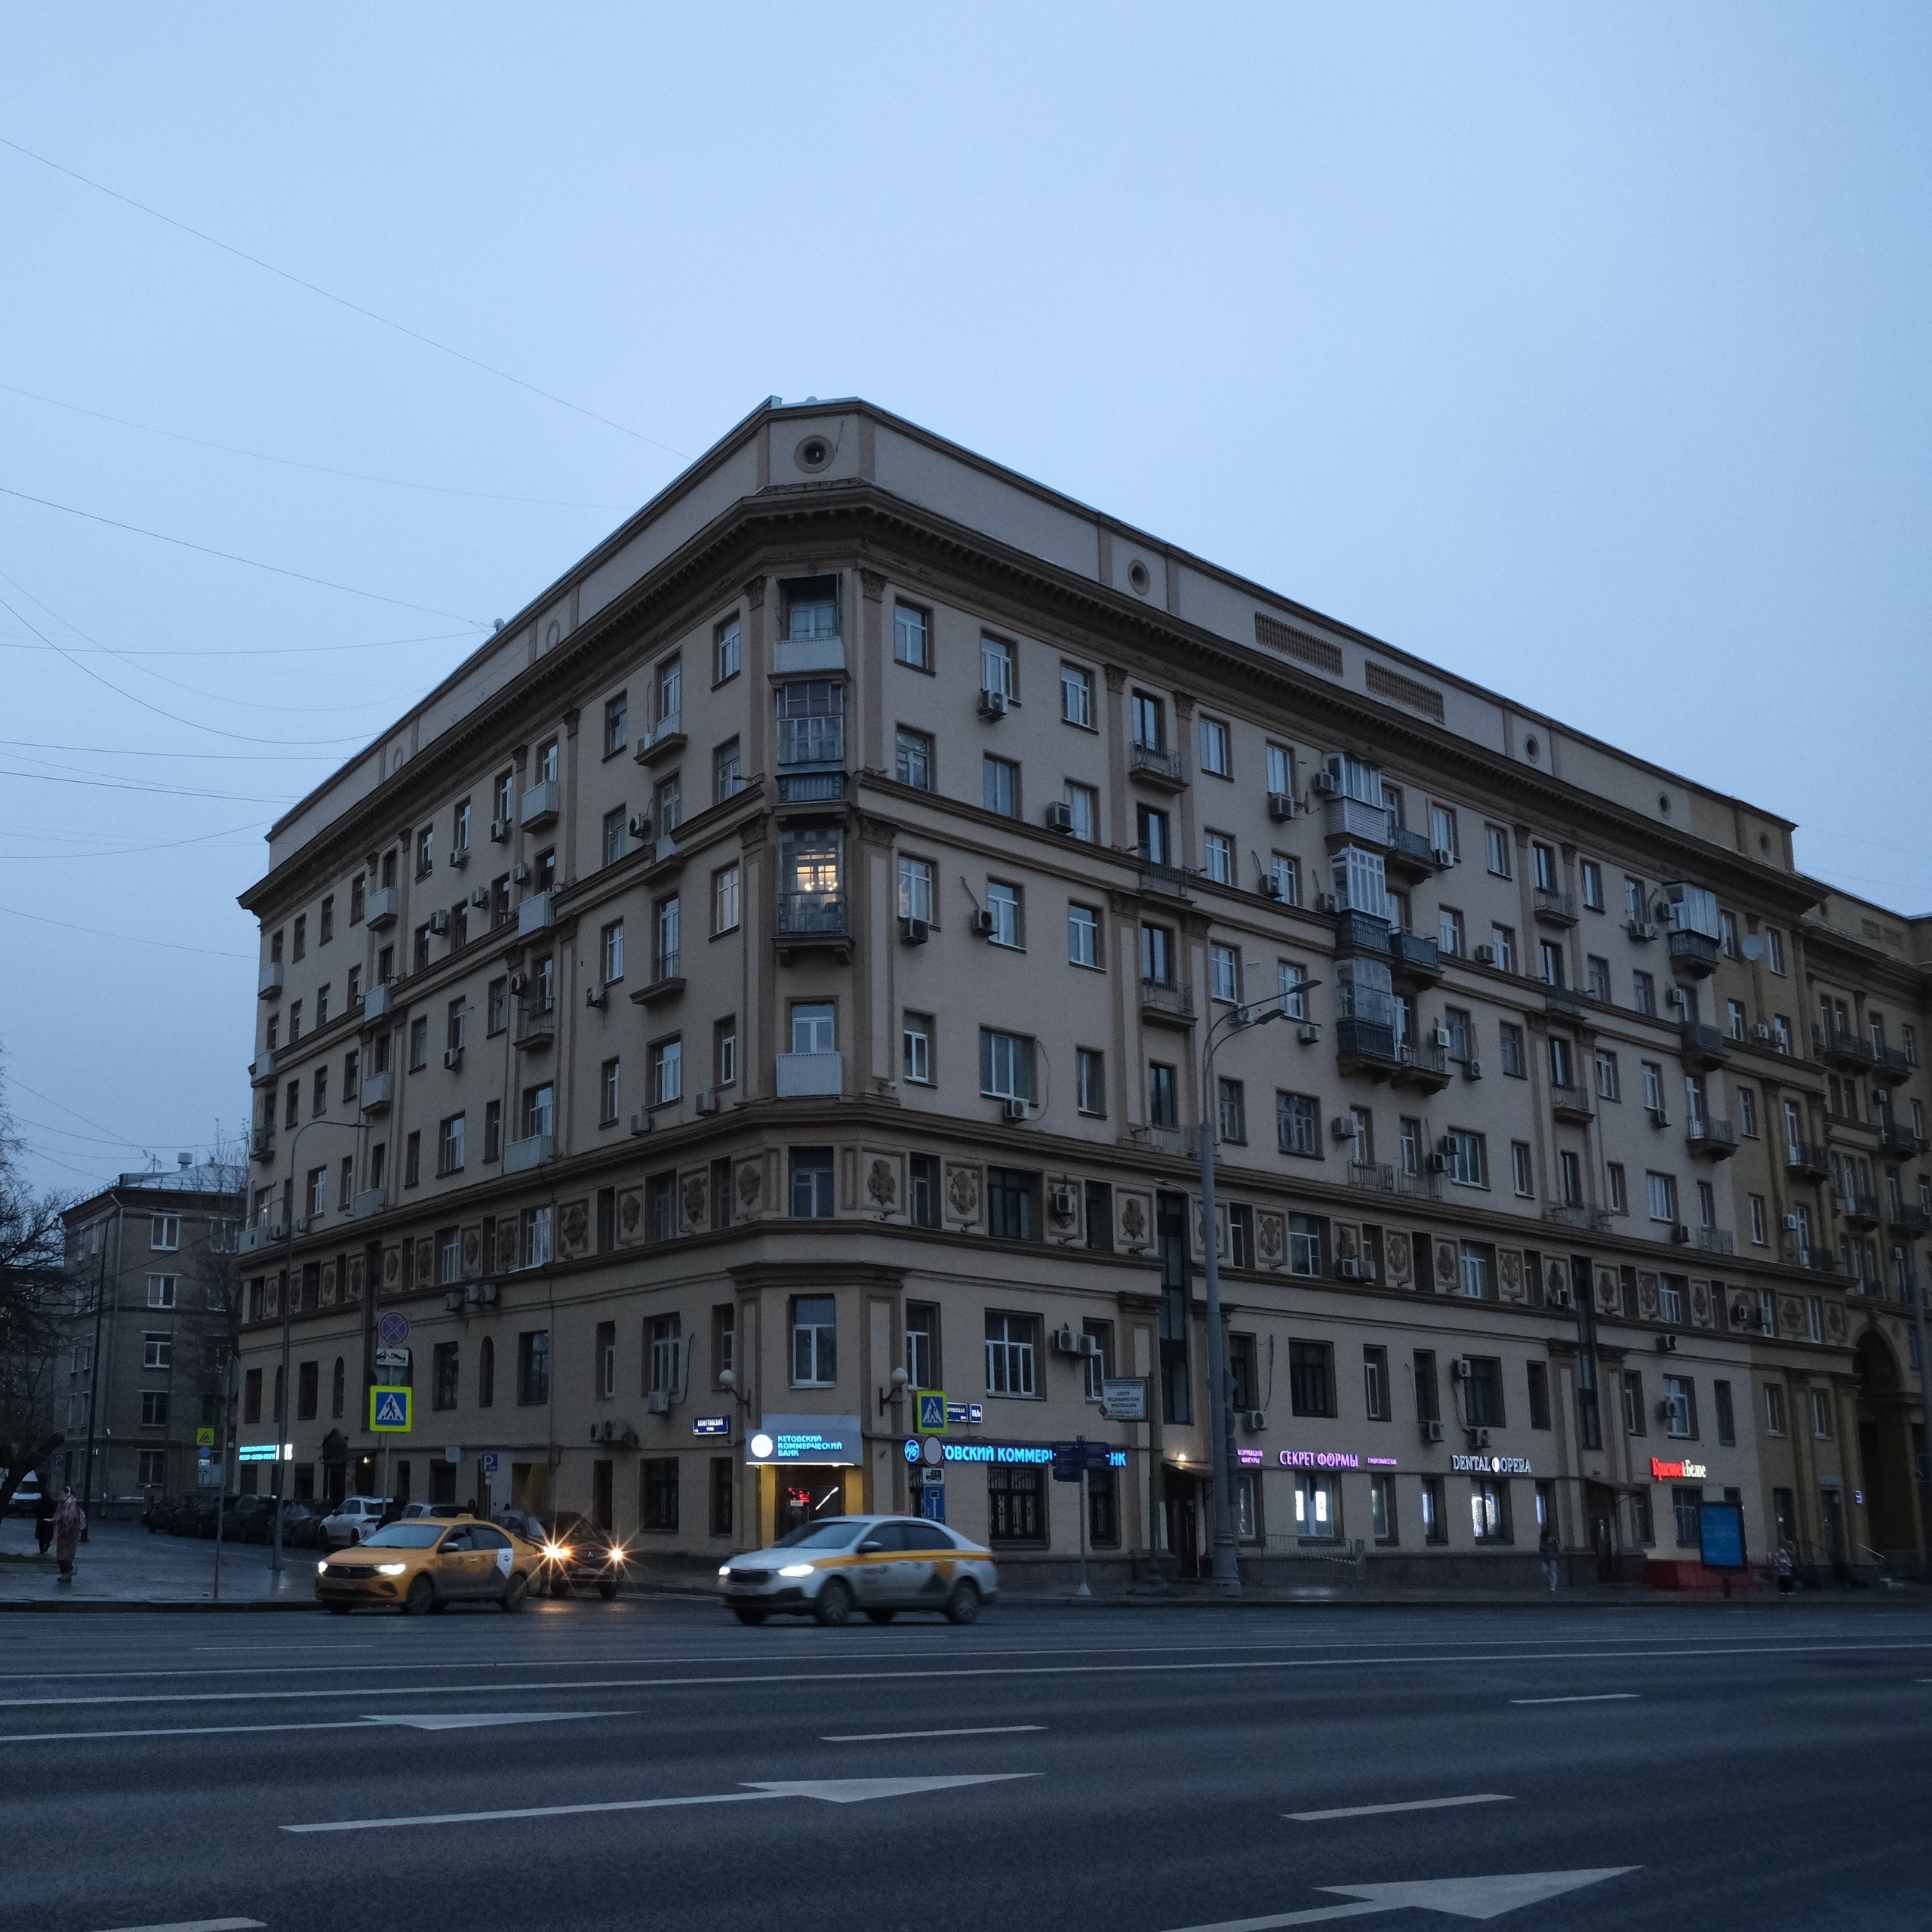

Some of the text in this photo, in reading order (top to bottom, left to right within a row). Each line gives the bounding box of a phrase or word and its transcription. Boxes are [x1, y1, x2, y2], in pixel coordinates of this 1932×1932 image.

[777, 1441, 843, 1451] КОММЕРЧЕСКИЙ
[943, 1444, 995, 1462] ОВСКИЙ
[1278, 1451, 1358, 1468] СЕКРЕТ ФОРМЫ
[1452, 1454, 1532, 1473] DENTAL OPERA
